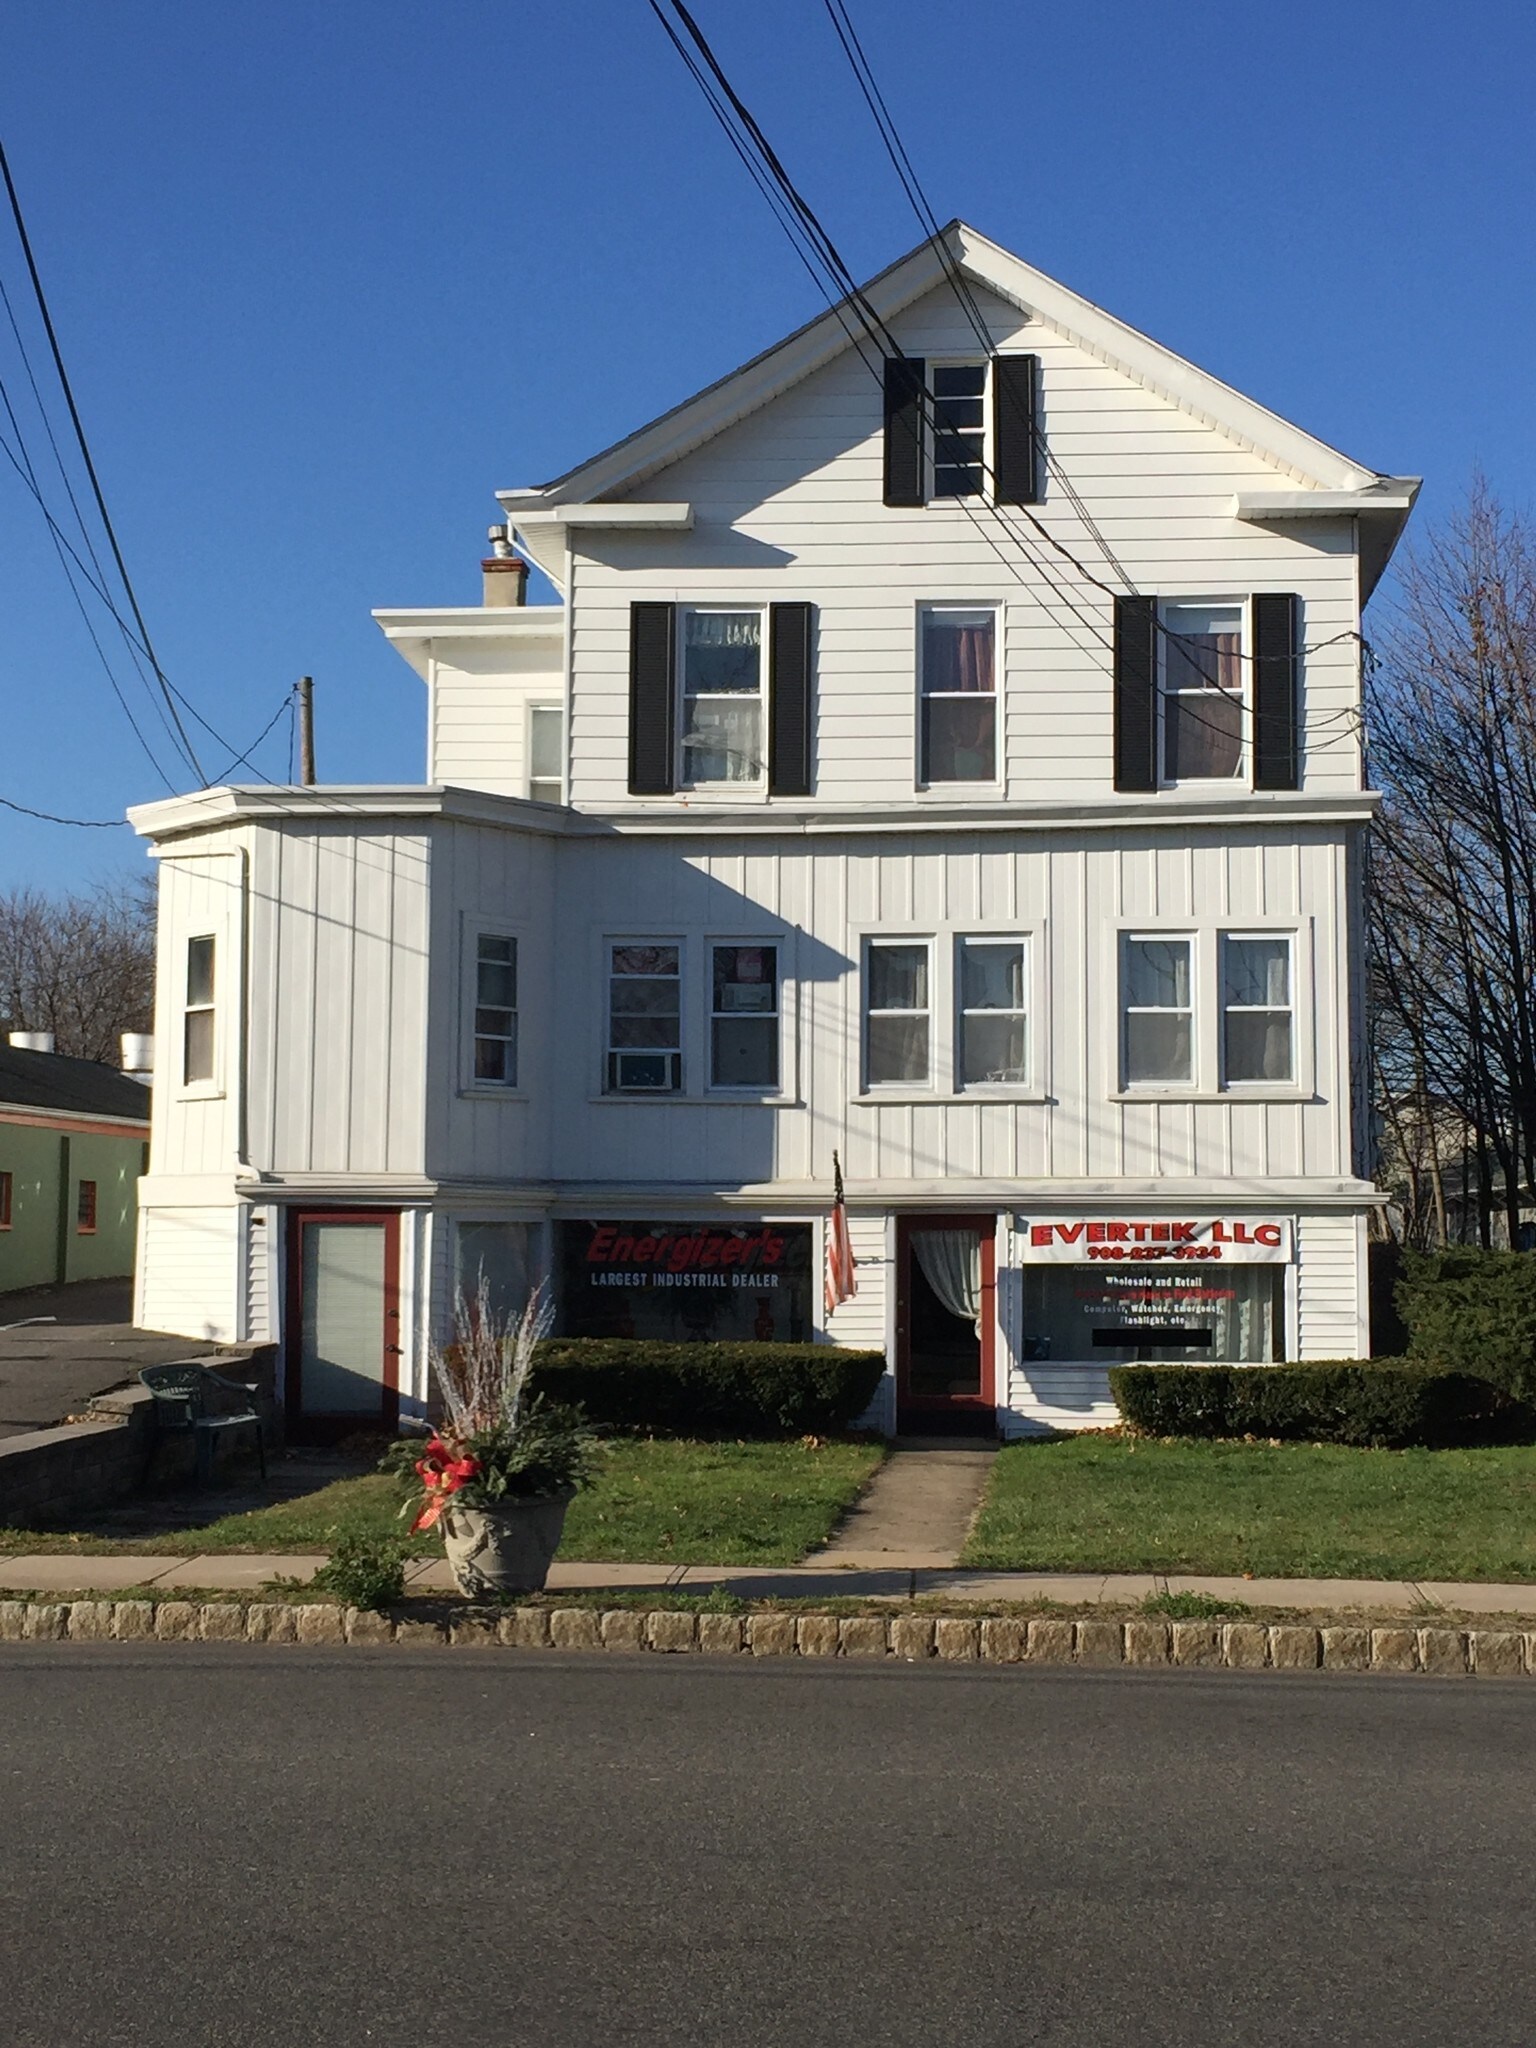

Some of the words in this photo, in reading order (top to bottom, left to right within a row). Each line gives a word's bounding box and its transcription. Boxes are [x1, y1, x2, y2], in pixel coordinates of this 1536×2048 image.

[1031, 1222, 1199, 1246] EVERTEK
[1212, 1222, 1281, 1246] LLC
[586, 1227, 784, 1271] Energizer's
[1087, 1246, 1222, 1260] 908-237-3934
[591, 1272, 648, 1287] LARGEST
[652, 1272, 727, 1288] INDUSTRIAL
[731, 1273, 779, 1288] DEALER
[1105, 1276, 1152, 1287] Wholesale
[1155, 1277, 1172, 1287] and
[1174, 1276, 1202, 1287] Retail
[1084, 1305, 1128, 1314] Computer,
[1131, 1305, 1171, 1313] Watches,
[1174, 1305, 1224, 1314] Emergency,
[1120, 1316, 1167, 1325] Flashlight,
